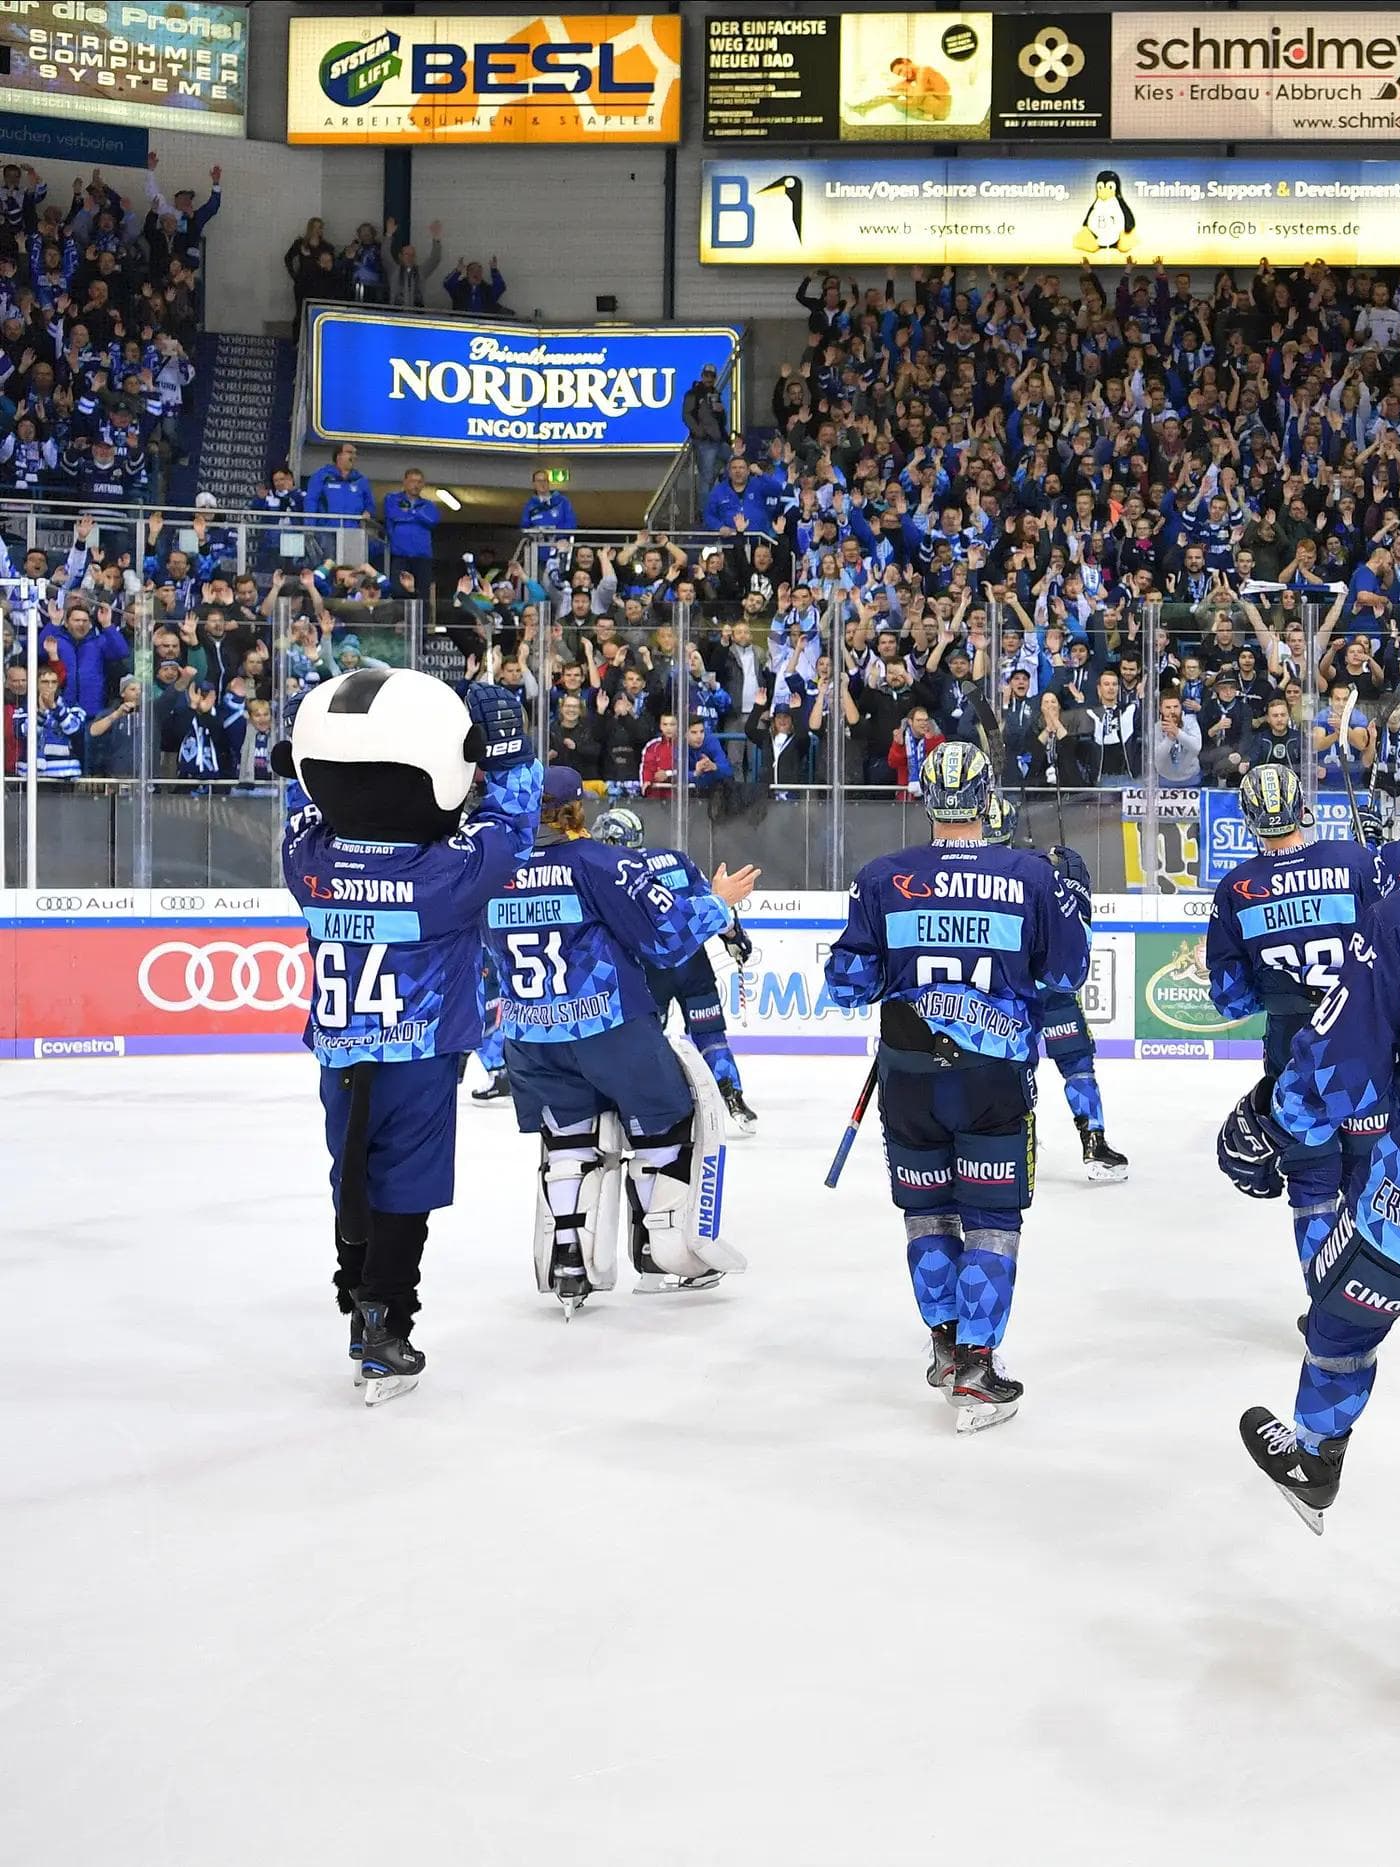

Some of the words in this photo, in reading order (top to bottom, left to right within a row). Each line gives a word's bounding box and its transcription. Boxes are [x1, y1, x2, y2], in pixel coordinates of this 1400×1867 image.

[710, 21, 740, 35] DER
[742, 20, 826, 35] EINFACHSTE
[29, 28, 239, 67] STRÖHMER
[330, 34, 390, 79] SYSTEM
[709, 37, 743, 52] WEG
[745, 37, 778, 52] ZUM
[29, 46, 239, 84] COMPUTER
[411, 43, 655, 94] BESL
[709, 53, 760, 68] NEUEN
[762, 53, 794, 68] BAD
[39, 64, 229, 99] SYSTEME
[357, 60, 392, 90] LIFT
[1016, 97, 1086, 112] elements
[1134, 84, 1174, 101] Kies
[1189, 84, 1259, 101] Erdbau
[1275, 84, 1362, 101] Abbruch
[324, 114, 514, 128] ARBEITSBÜHNEN
[532, 116, 541, 127] &
[560, 115, 655, 128] STAPLER
[825, 181, 919, 201] Linux/Open
[922, 181, 977, 199] Source
[979, 181, 1070, 202] Consulting,
[1134, 181, 1206, 202] Training,
[1207, 181, 1272, 202] Support
[1276, 181, 1290, 198] &
[469, 336, 608, 366] Privatbrauerei
[389, 358, 676, 417] NORDBRÄU
[467, 418, 607, 441] INGOLSTADT
[1265, 771, 1280, 810] EDEKA
[1268, 816, 1282, 826] 22
[515, 865, 574, 890] SATURN
[934, 871, 1024, 904] SATURN
[1271, 867, 1350, 895] SATURN
[86, 896, 135, 910] Audi
[330, 878, 414, 903] SATURN
[214, 897, 260, 910] Audi
[497, 900, 562, 925] PIELMEIER
[759, 899, 801, 911] Audi
[1263, 900, 1322, 930] BAILEY
[917, 915, 990, 944] ELSNER
[506, 931, 568, 999] 51
[315, 942, 404, 1029] 64
[689, 1004, 721, 1020] CINQUE
[1042, 1021, 1078, 1038] CINQUE
[42, 1039, 115, 1054] covestro
[1142, 1042, 1208, 1057] covestro
[957, 1157, 1016, 1180] CINQUE
[698, 1155, 717, 1238] VAUGHN
